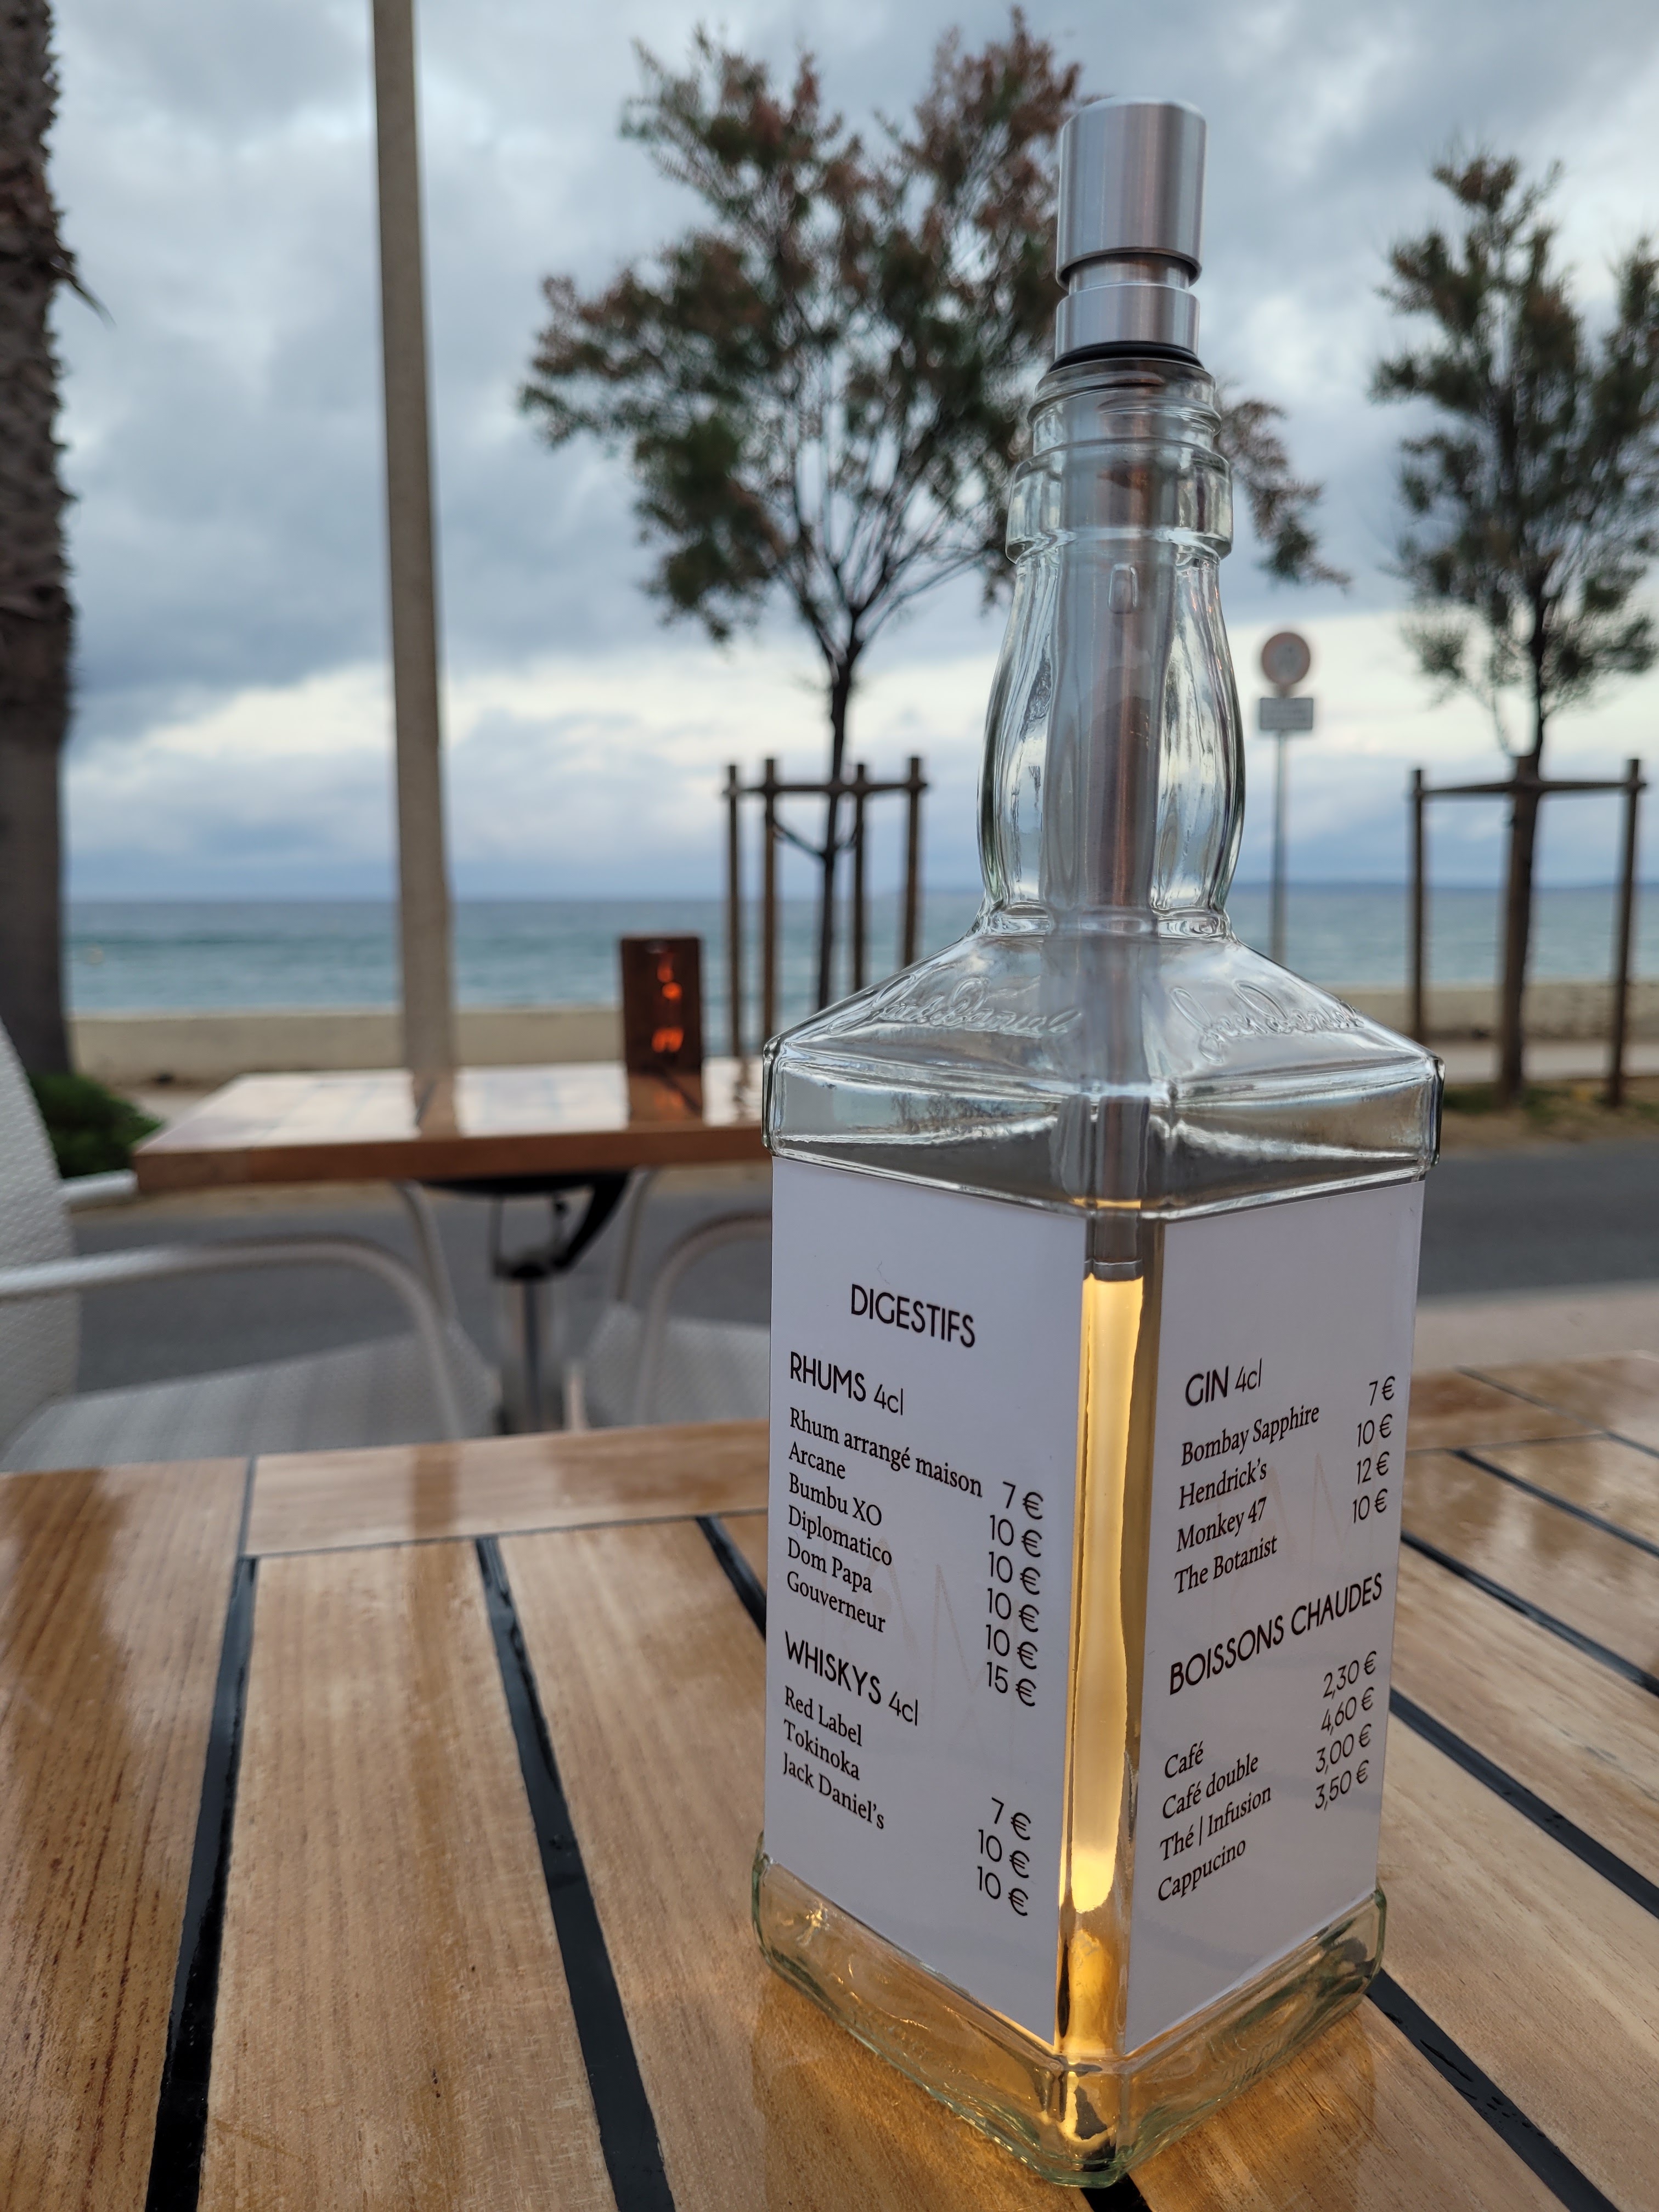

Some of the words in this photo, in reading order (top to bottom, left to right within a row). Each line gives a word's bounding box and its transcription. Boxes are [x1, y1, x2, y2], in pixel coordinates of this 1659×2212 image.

[851, 1283, 975, 1348] DIGESTIFS
[790, 1351, 866, 1402] RHUMS
[873, 1384, 904, 1416] 4cl
[1181, 1428, 1250, 1466] Bombay
[1252, 1405, 1319, 1444] Sapphire
[1368, 1380, 1379, 1406] 7
[1381, 1375, 1396, 1401] €
[1185, 1365, 1229, 1407] GIN
[1234, 1358, 1262, 1392] 4cl
[1357, 1419, 1375, 1448] 10
[1378, 1413, 1393, 1439] €
[788, 1441, 846, 1480] Arcane
[990, 1514, 1014, 1547] 10
[1020, 1529, 1043, 1558] €
[789, 1407, 840, 1444] Rhum
[844, 1432, 911, 1472] arrangé
[915, 1458, 983, 1498] maison
[1002, 1481, 1017, 1509] 7
[1022, 1491, 1043, 1520] €
[1176, 1511, 1245, 1553] Monkey
[1248, 1496, 1267, 1523] 47
[1357, 1457, 1372, 1485] 12
[1375, 1451, 1390, 1476] €
[788, 1504, 893, 1566] Diplomatico
[987, 1588, 1012, 1620] 10
[1018, 1604, 1040, 1633] €
[789, 1472, 849, 1515] Bumbu
[852, 1497, 882, 1526] XO
[989, 1551, 1013, 1583] 10
[1019, 1566, 1041, 1594] €
[1173, 1564, 1209, 1594] The
[1212, 1535, 1278, 1580] Botanist
[1352, 1495, 1370, 1524] 10
[1374, 1488, 1388, 1514] €
[787, 1536, 827, 1574] Dom
[831, 1555, 873, 1594] Papa
[985, 1624, 1011, 1657] 10
[1017, 1641, 1039, 1670] €
[787, 1571, 886, 1633] Gouverneur
[986, 1661, 1008, 1694] 15
[1015, 1678, 1037, 1707] €
[1170, 1615, 1284, 1696] BOISSONS
[1291, 1572, 1383, 1635] CHAUDES
[785, 1630, 882, 1705] WHISKYS
[888, 1691, 918, 1726] 4cl
[1164, 1740, 1204, 1779] Café
[1322, 1660, 1360, 1699] 2,30
[1363, 1650, 1377, 1675] €
[783, 1719, 860, 1781] Tokinoka
[978, 1829, 1003, 1863] 10
[1009, 1850, 1030, 1879] €
[785, 1685, 814, 1720] Red
[818, 1705, 862, 1747] Label
[991, 1797, 1005, 1825] 7
[1010, 1812, 1032, 1841] €
[1159, 1824, 1194, 1861] Thé
[1198, 1815, 1203, 1847] |
[1207, 1787, 1272, 1837] Infusion
[1315, 1733, 1355, 1774] 3,00
[1358, 1723, 1372, 1748] €
[1162, 1780, 1201, 1819] Café
[1205, 1753, 1259, 1798] double
[1321, 1696, 1357, 1735] 4,60
[1361, 1686, 1374, 1712] €
[783, 1752, 815, 1789] Jack
[977, 1865, 1001, 1899] 10
[1007, 1888, 1029, 1917] €
[1158, 1839, 1246, 1901] Cappucino
[1314, 1770, 1352, 1810] 3,50
[1356, 1759, 1369, 1785] €
